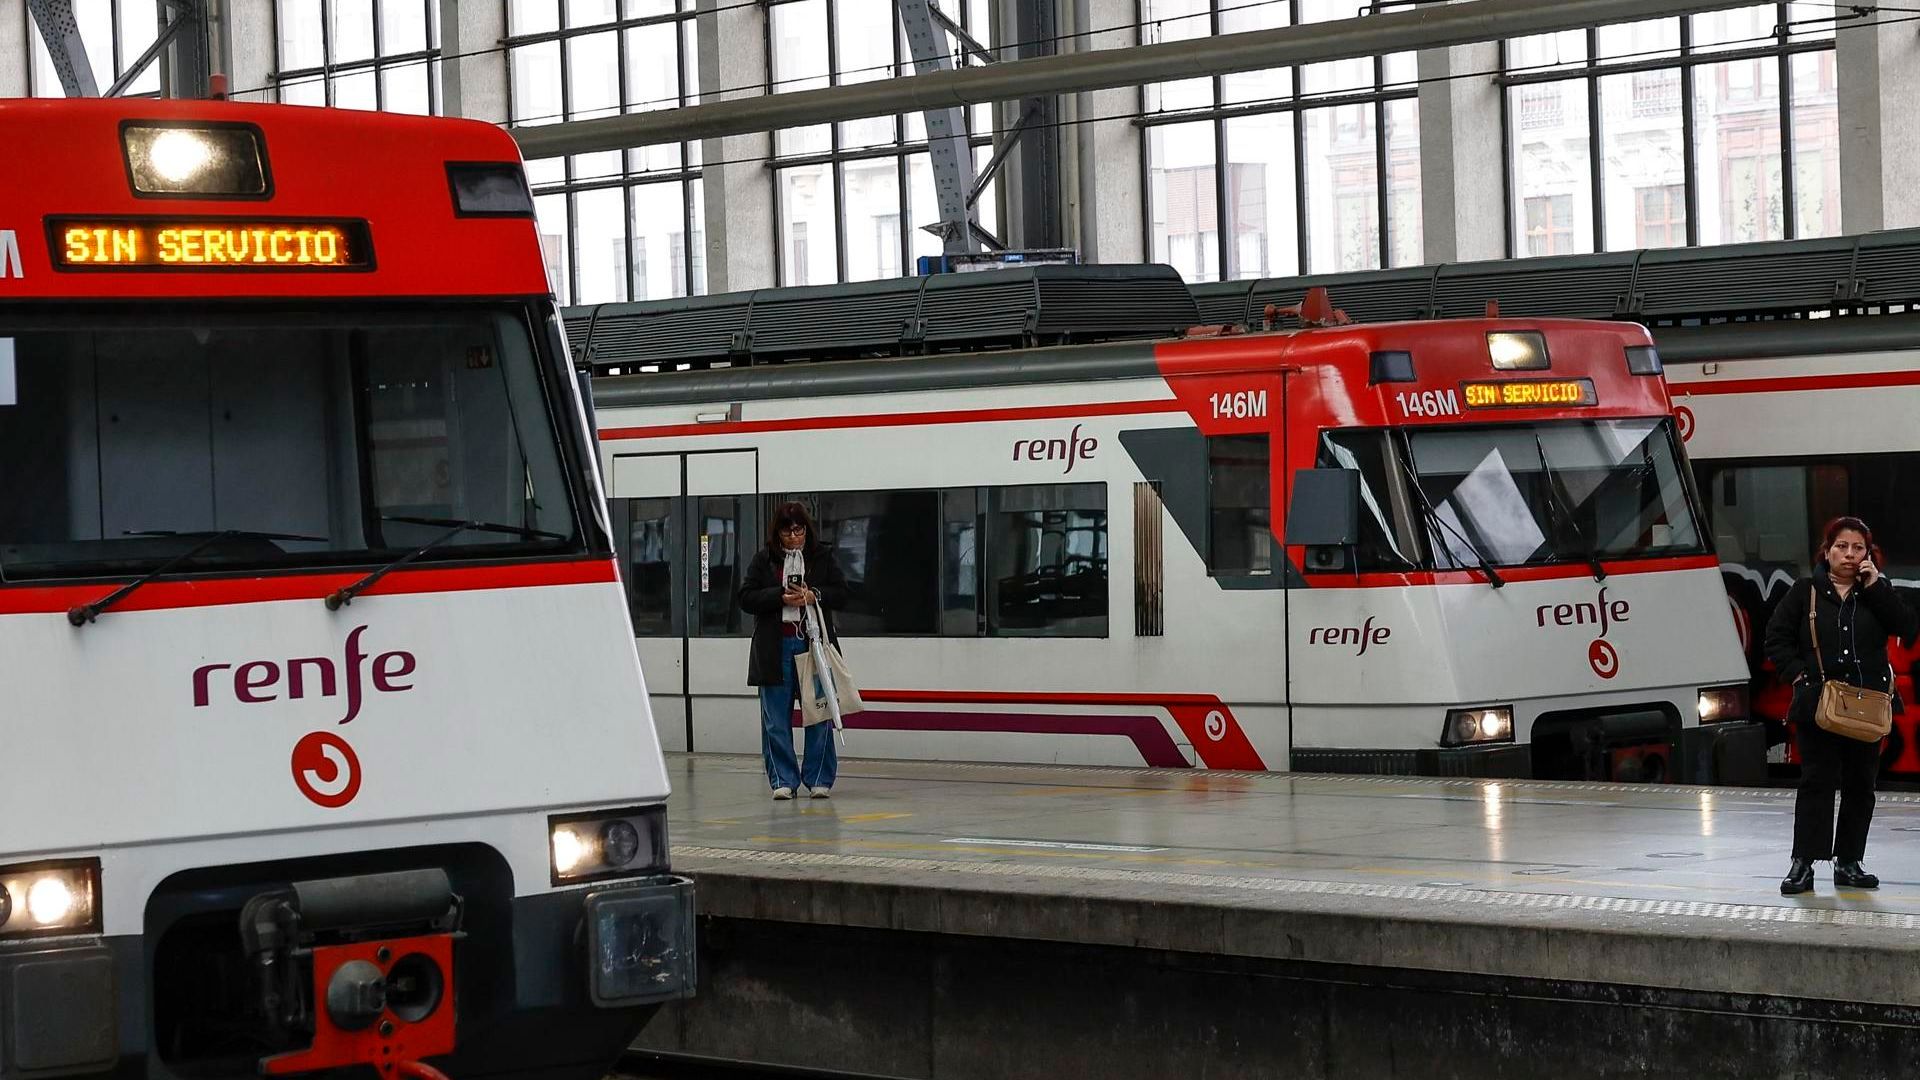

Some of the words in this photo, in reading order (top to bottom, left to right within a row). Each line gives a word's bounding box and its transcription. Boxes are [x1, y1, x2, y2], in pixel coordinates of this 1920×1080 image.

[65, 229, 137, 262] SIN
[157, 230, 337, 262] SERVICIO
[1209, 390, 1267, 419] 146M
[1396, 389, 1460, 417] 146M
[1465, 385, 1495, 405] SIN
[1503, 383, 1578, 404] SERVICIO
[1012, 423, 1098, 475] renfe
[1536, 586, 1630, 638] renfe
[1309, 615, 1391, 657] renfe
[192, 624, 416, 725] renfe
